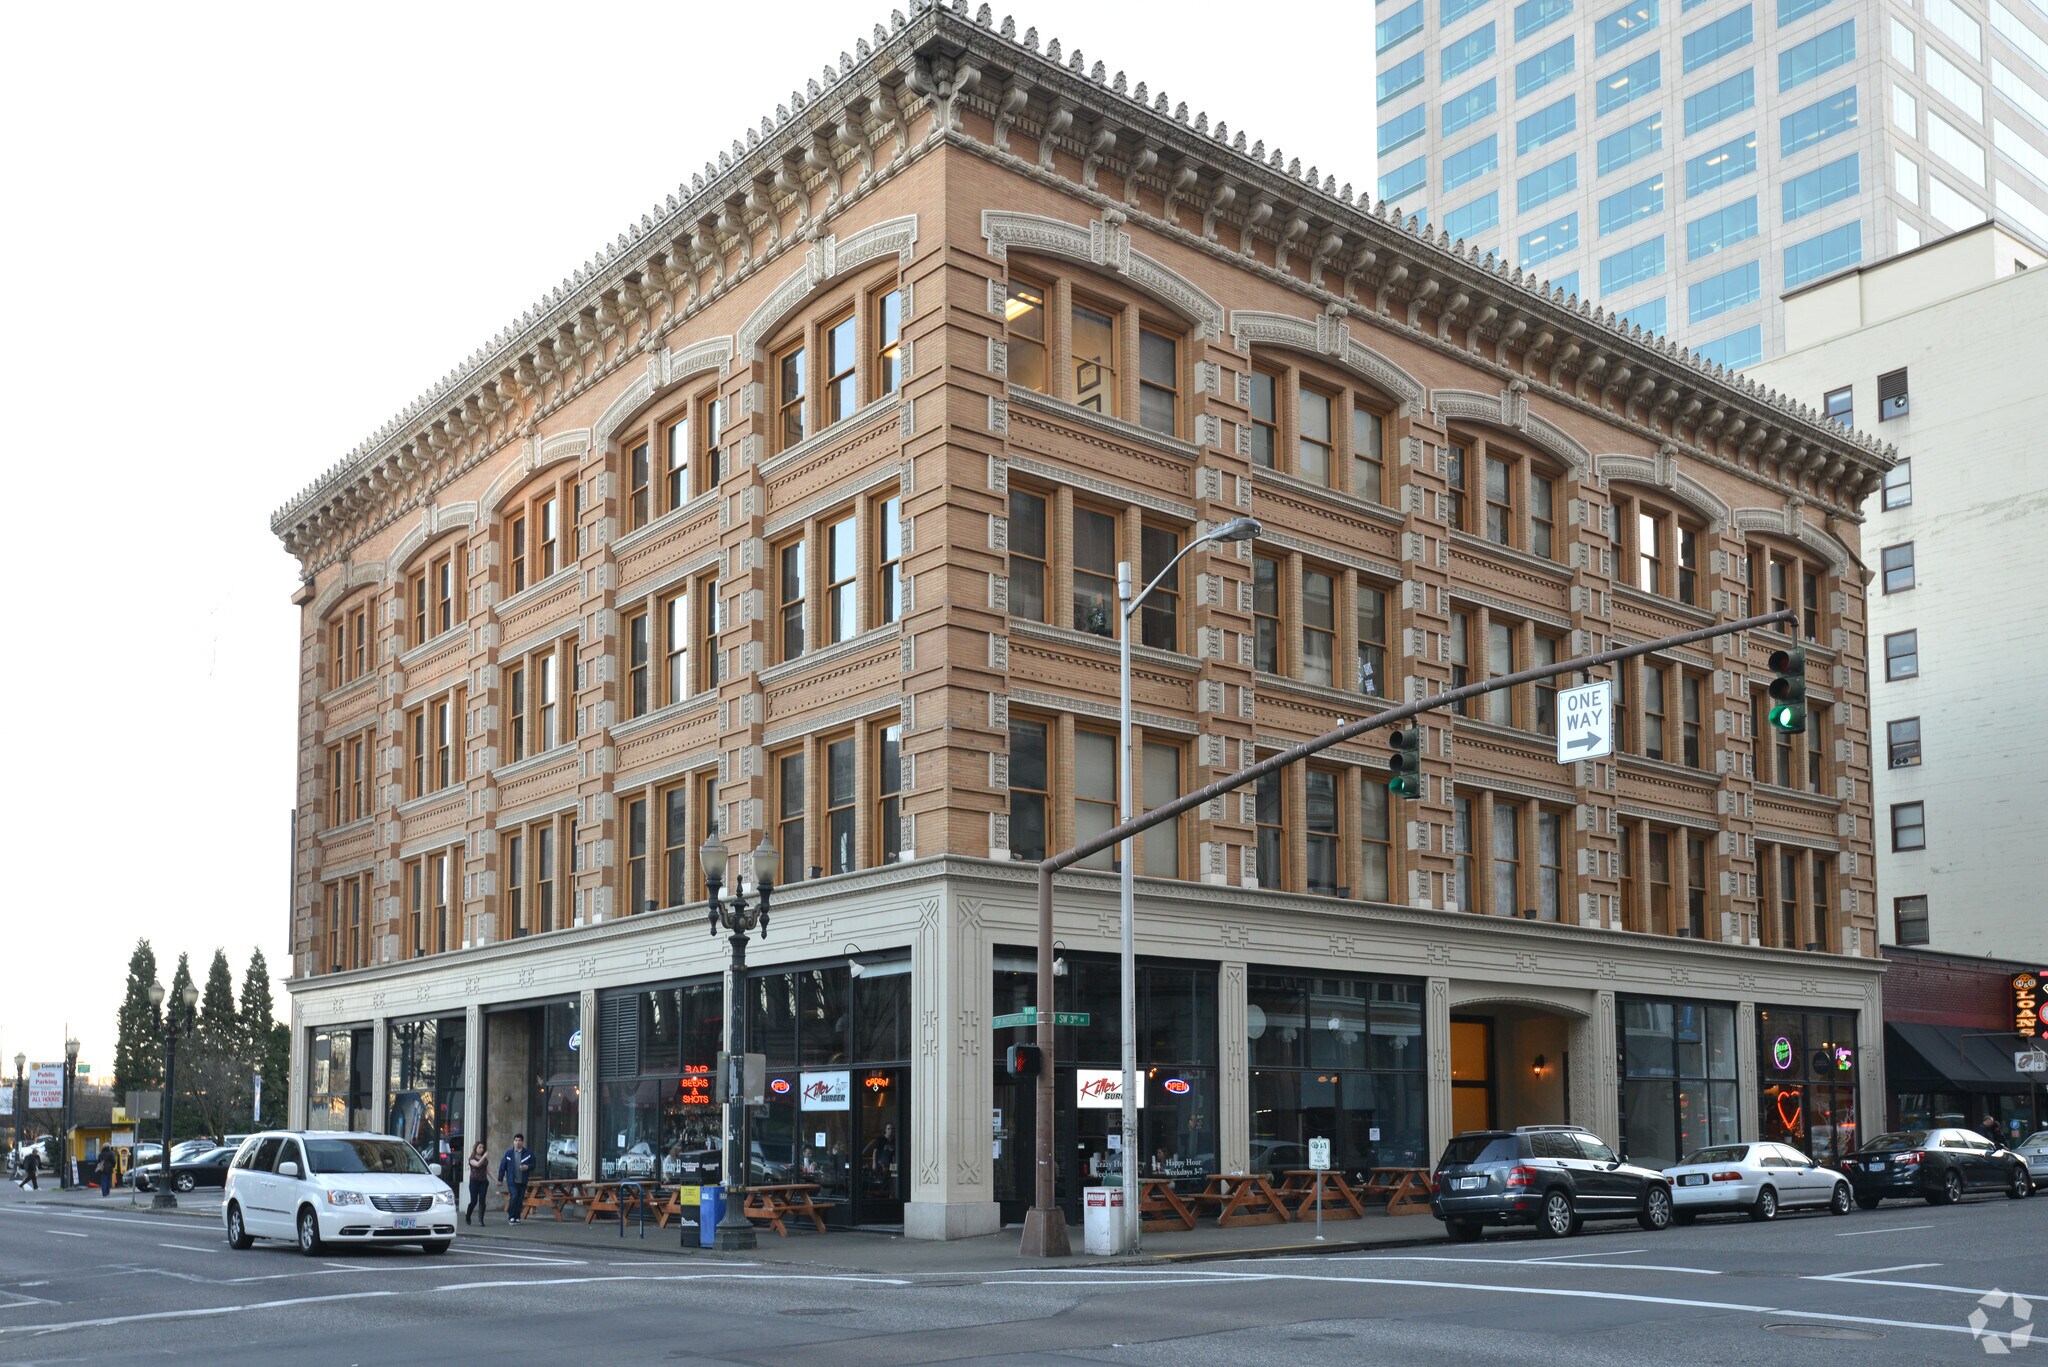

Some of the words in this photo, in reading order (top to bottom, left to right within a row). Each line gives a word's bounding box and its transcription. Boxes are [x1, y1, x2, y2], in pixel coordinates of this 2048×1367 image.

[1567, 690, 1601, 711] ONE
[1567, 709, 1602, 731] WAY
[1058, 1014, 1068, 1024] SW
[2016, 991, 2037, 1037] LOANS
[685, 1065, 708, 1074] BAR
[682, 1079, 709, 1087] BEERS
[773, 1082, 788, 1091] OPEN
[866, 1077, 889, 1087] ORDER!
[1166, 1082, 1187, 1091] OPEN
[691, 1087, 698, 1095] &
[804, 1081, 834, 1104] Killer
[1080, 1078, 1123, 1101] Killer
[682, 1095, 709, 1104] SHOTS
[821, 1094, 846, 1102] BURGER
[1095, 1160, 1113, 1171] Crazy
[1113, 1160, 1123, 1168] Ho
[1166, 1159, 1185, 1168] Happy
[1186, 1158, 1202, 1166] Hour
[1165, 1168, 1193, 1177] Weekdays
